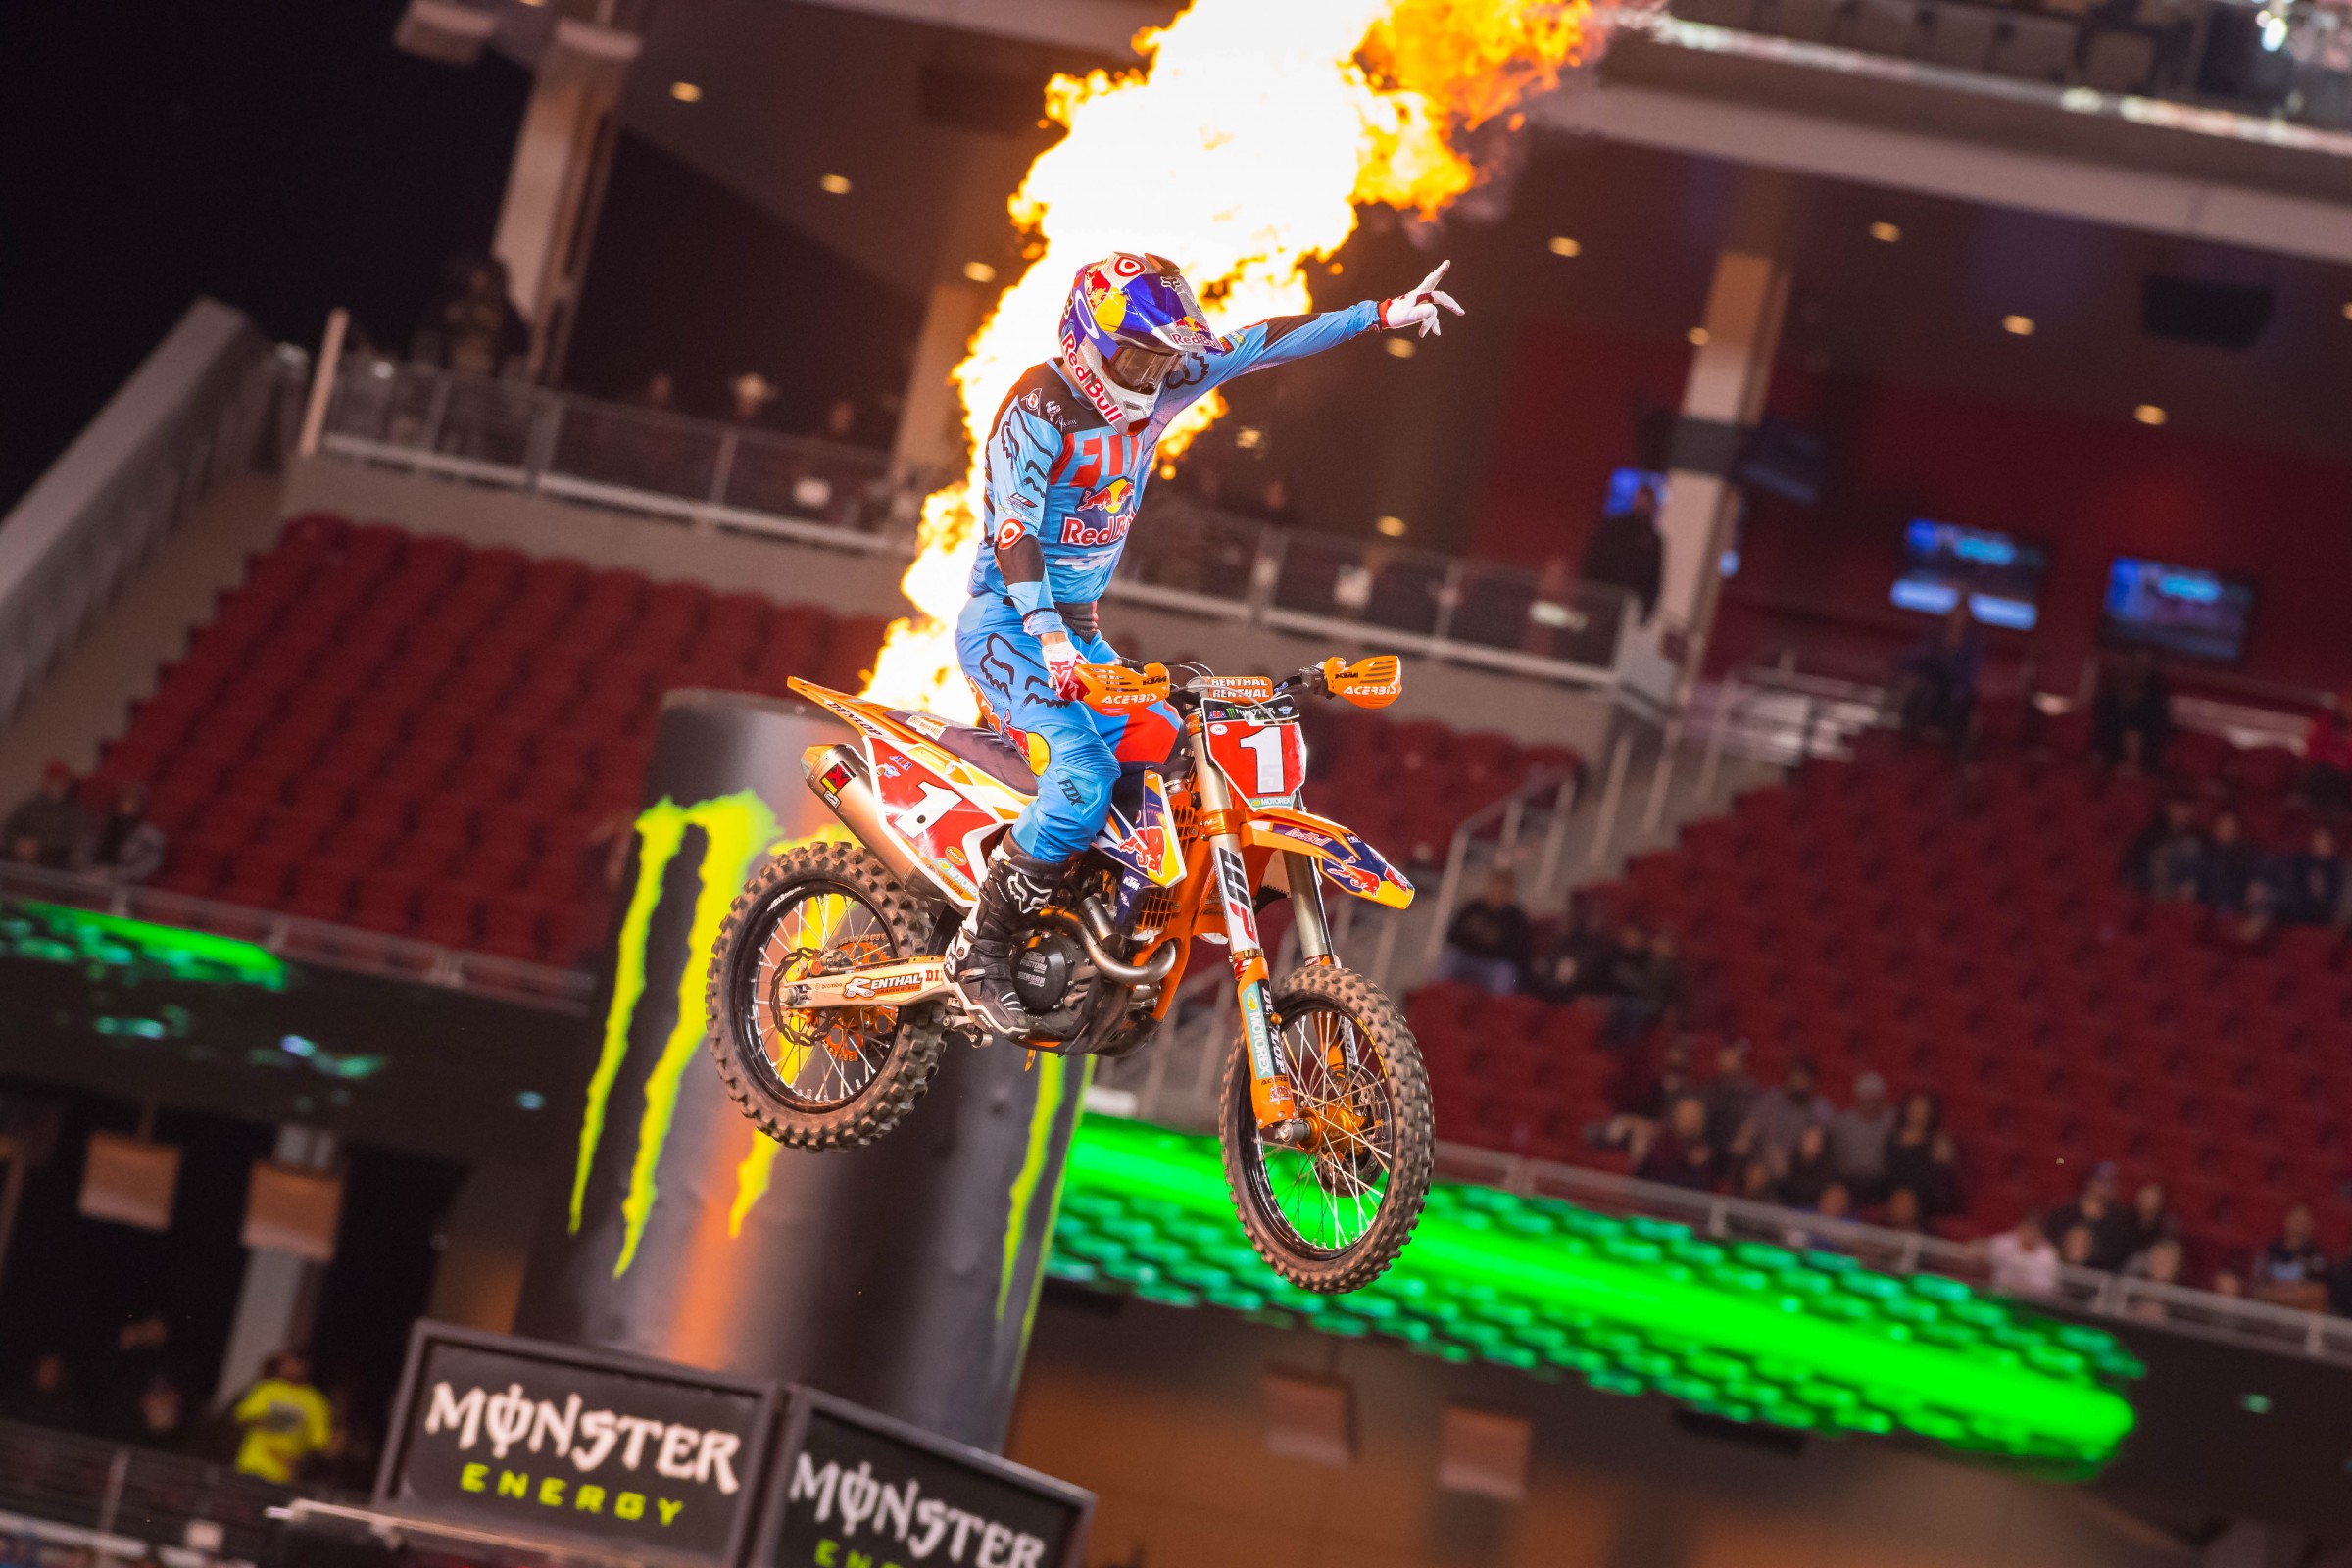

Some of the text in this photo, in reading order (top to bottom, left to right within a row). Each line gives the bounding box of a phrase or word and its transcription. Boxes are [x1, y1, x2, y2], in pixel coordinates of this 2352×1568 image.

[1142, 676, 1167, 686] KTM
[1212, 688, 1270, 698] RENTHAL
[828, 703, 883, 736] DUNLOP
[1240, 726, 1286, 795] 1
[893, 780, 964, 839] 1
[1058, 779, 1085, 806] FOX
[1260, 798, 1291, 807] MOTOREX
[925, 970, 943, 982] DI
[1250, 1012, 1271, 1076] MOTOREX
[425, 1381, 742, 1494] MONSTER
[461, 1462, 683, 1527] ENERGY
[789, 1451, 1047, 1568] MONSTER
